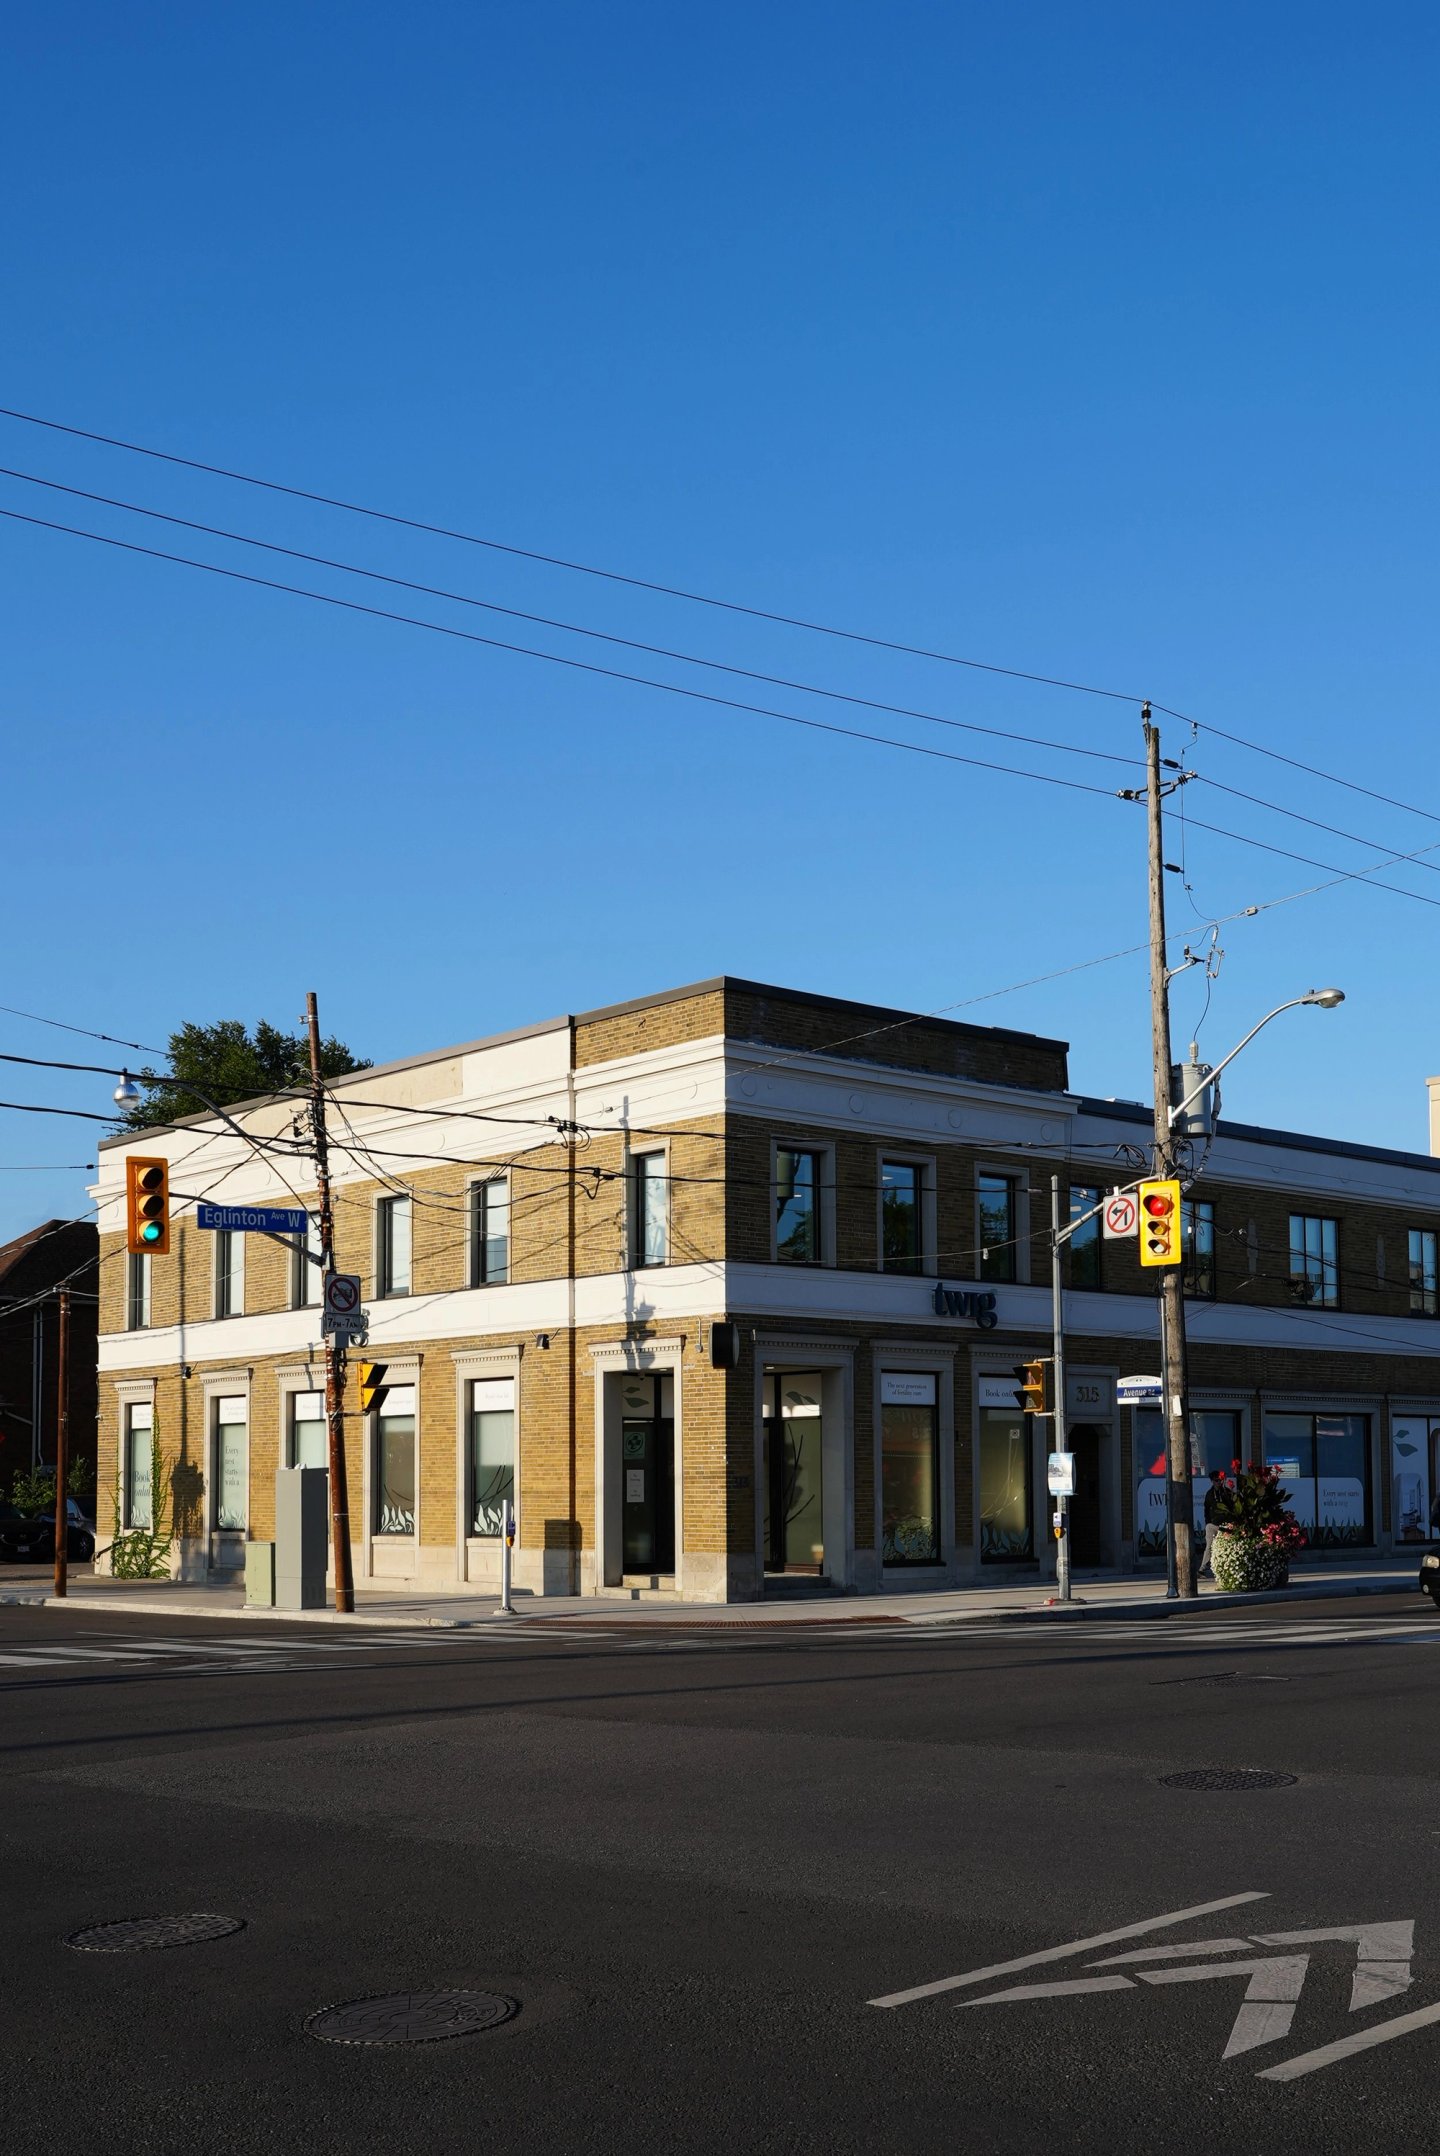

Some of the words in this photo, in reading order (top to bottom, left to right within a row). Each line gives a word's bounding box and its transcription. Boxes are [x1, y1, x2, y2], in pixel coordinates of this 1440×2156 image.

[205, 1207, 266, 1228] Eglinton
[271, 1211, 286, 1221] Ave
[287, 1212, 300, 1228] W
[932, 1282, 998, 1328] twig
[985, 1388, 1000, 1397] Book
[1076, 1386, 1099, 1402] 315
[1123, 1388, 1147, 1397] Avenue
